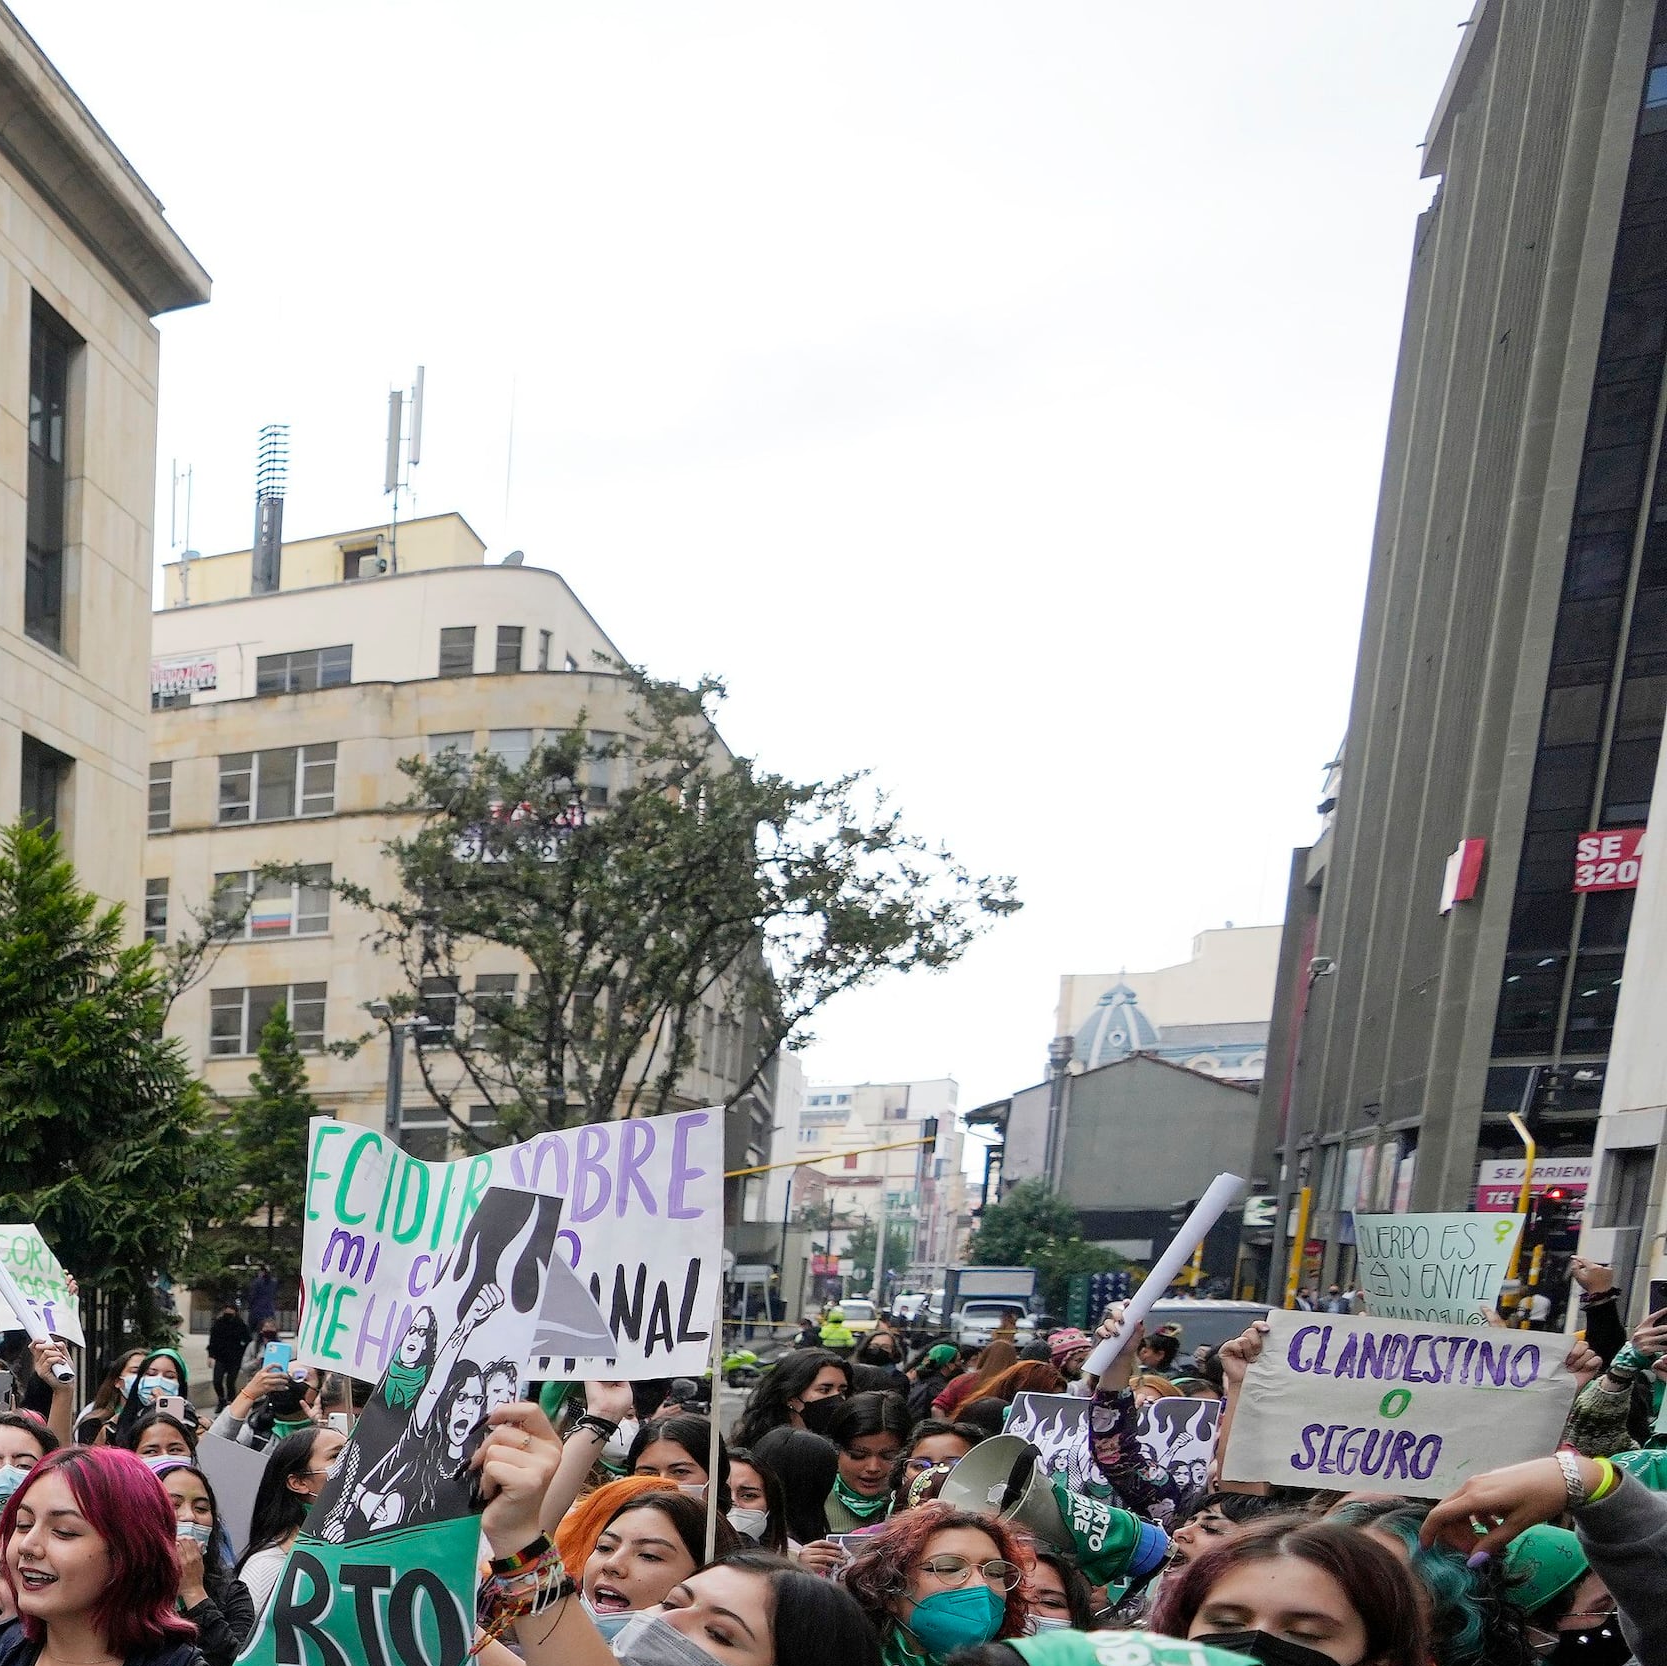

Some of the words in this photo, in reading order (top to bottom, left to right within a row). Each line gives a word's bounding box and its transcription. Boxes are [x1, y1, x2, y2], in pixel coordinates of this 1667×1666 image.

[1576, 836, 1623, 861] SE
[511, 1113, 709, 1223] SOBRE
[1440, 1222, 1478, 1260] ES
[1287, 1324, 1540, 1389] CLANDESTINO
[1379, 1388, 1412, 1419] O
[1291, 1423, 1443, 1480] SEGURO
